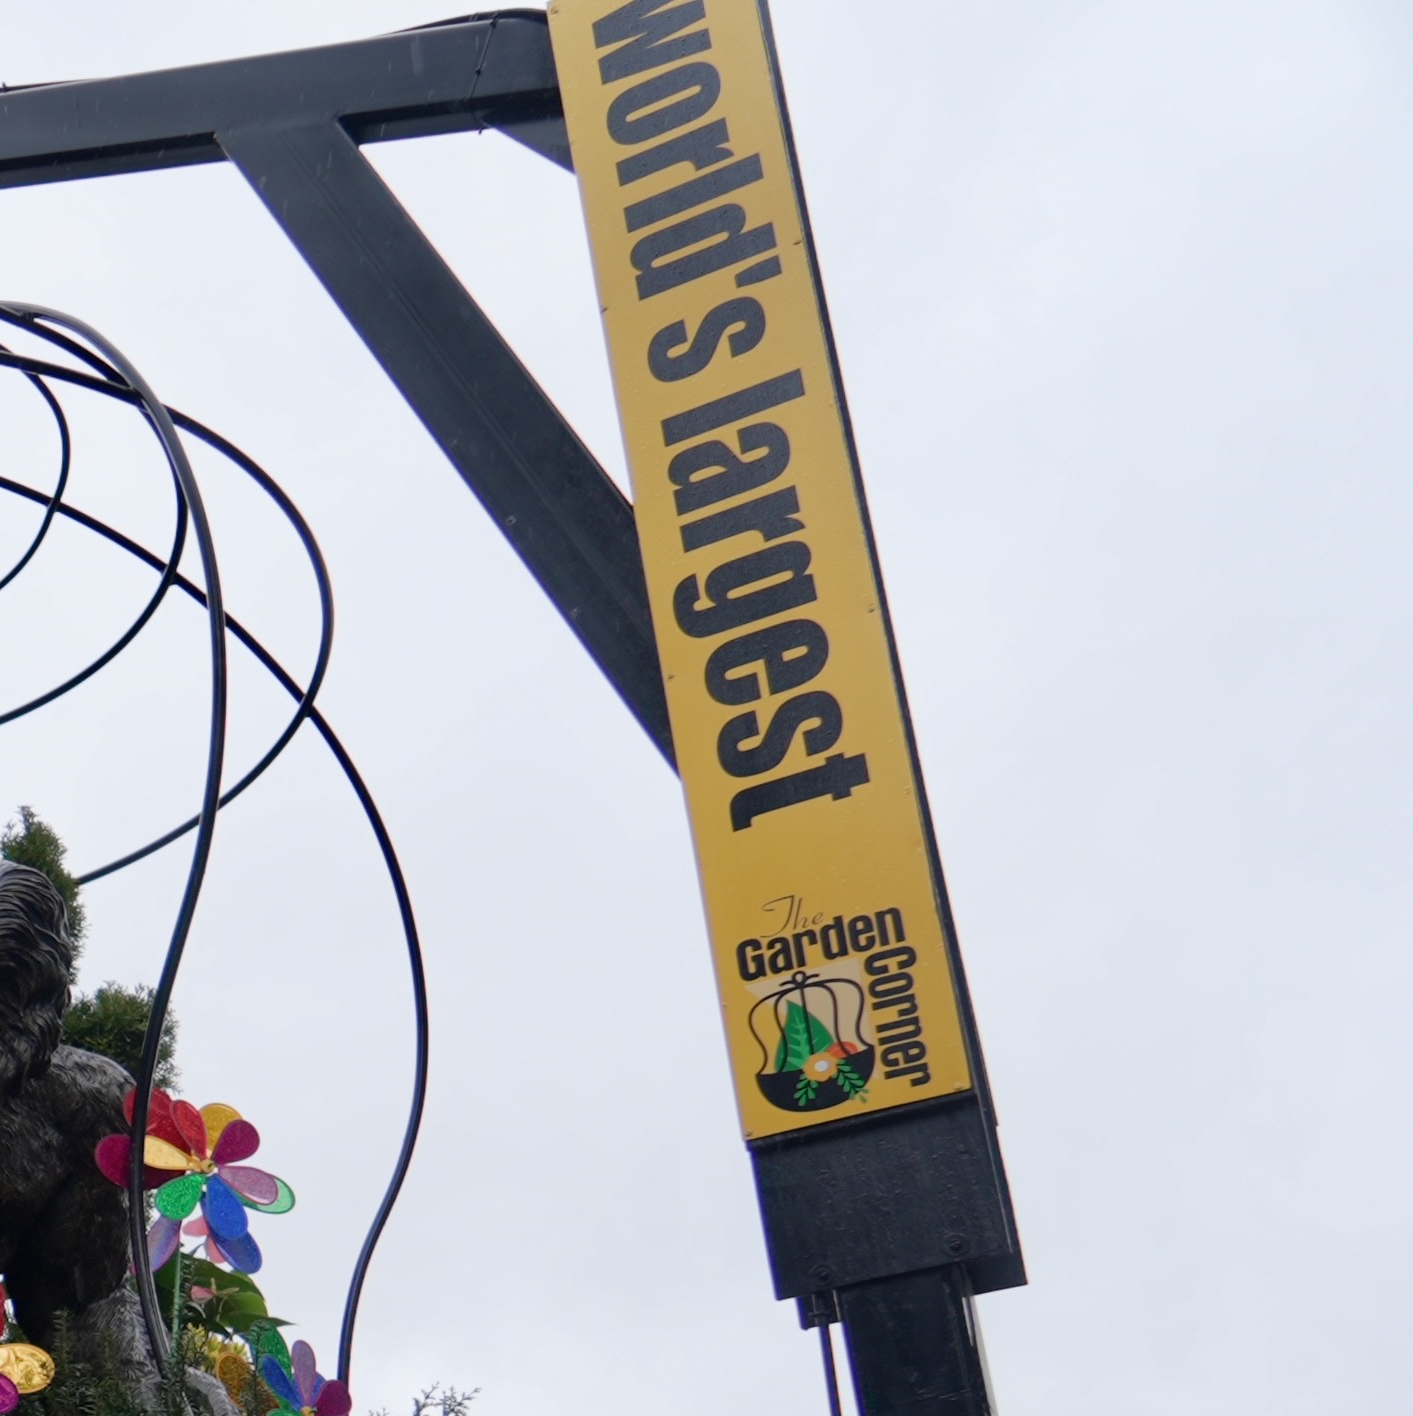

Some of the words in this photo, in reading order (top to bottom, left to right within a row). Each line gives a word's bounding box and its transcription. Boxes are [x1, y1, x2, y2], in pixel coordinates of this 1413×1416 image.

[591, 0, 783, 383] world's
[659, 368, 871, 833] largest
[735, 906, 906, 982] Garden
[760, 894, 823, 938] The
[863, 945, 932, 1088] Corner
